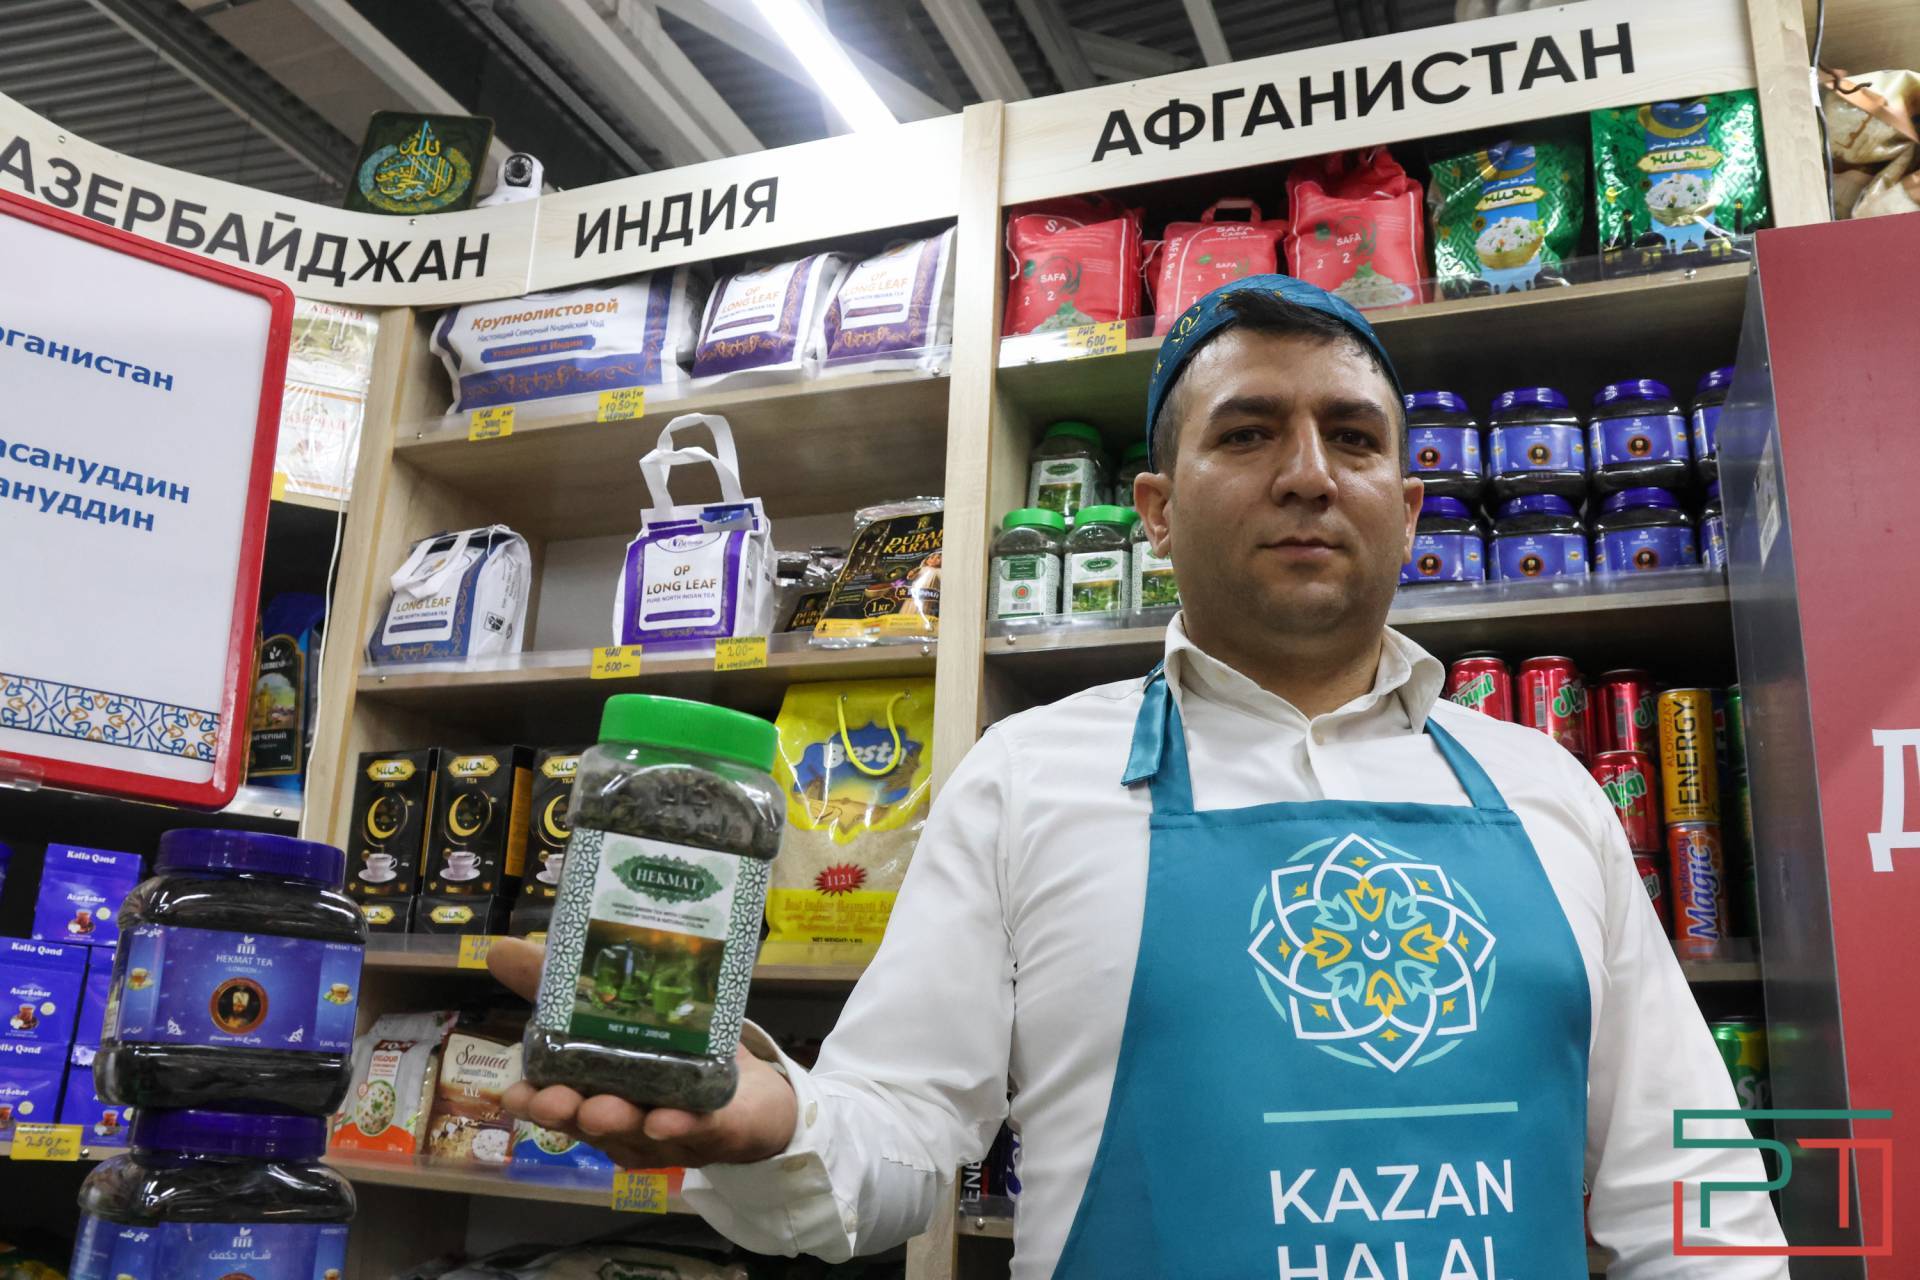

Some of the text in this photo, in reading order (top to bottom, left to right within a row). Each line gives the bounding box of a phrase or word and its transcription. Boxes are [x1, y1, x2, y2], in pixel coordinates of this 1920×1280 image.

[1091, 22, 1636, 163] АФГАНИСТАН
[0, 136, 490, 288] АЗЕРБАЙДЖАН
[574, 176, 779, 259] ИНДИЯ
[1336, 232, 1362, 247] SAFA
[1343, 253, 1351, 264] 2
[1040, 273, 1067, 283] SAFA
[1047, 290, 1056, 301] 2
[471, 298, 620, 332] Крупнолистовой
[673, 565, 690, 577] OP
[646, 578, 717, 596] LONG LEAF
[396, 596, 452, 613] LONG LEAF
[1676, 700, 1701, 805] ENERGY
[376, 766, 406, 776] HILAL
[457, 761, 489, 772] HILAL
[551, 762, 579, 772] HILA
[92, 853, 117, 865] Qand
[634, 867, 701, 891] HEKMAT
[826, 873, 852, 887] 1121
[1686, 845, 1721, 942] Magic
[37, 944, 63, 957] Qand
[216, 954, 273, 967] HEKMAT TEA
[608, 1022, 624, 1033] NET
[15, 1044, 41, 1056] Qand
[1269, 1159, 1514, 1225] KAZAN
